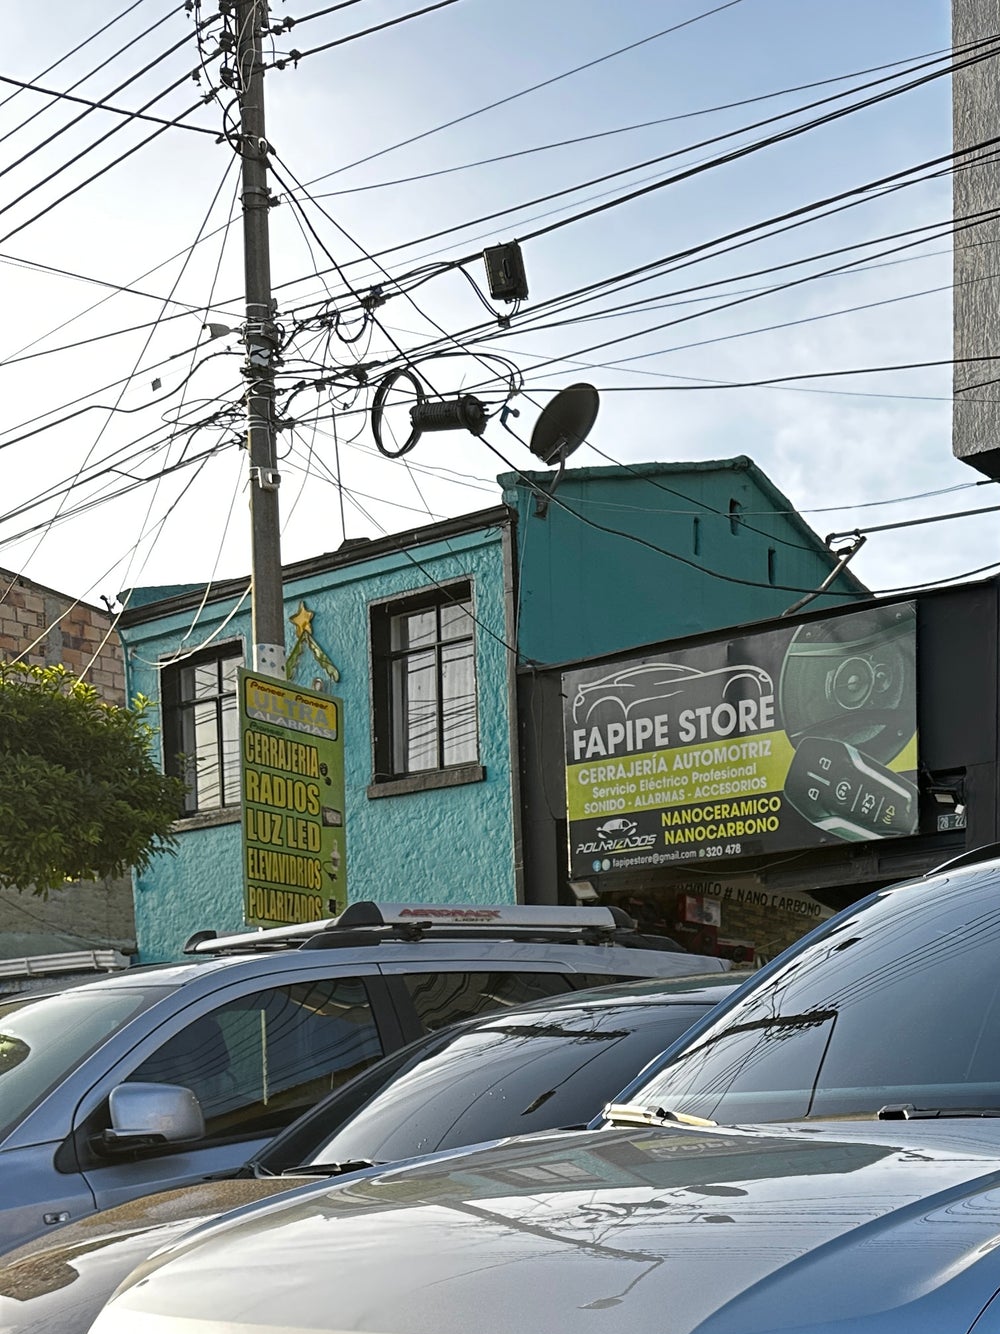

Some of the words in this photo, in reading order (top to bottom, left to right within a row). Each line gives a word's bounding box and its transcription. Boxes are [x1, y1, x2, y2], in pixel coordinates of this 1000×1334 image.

[254, 690, 329, 725] ULTRA
[294, 694, 329, 710] Pioneer
[253, 711, 331, 738] ALARMAS
[573, 714, 669, 761] FAPIPE
[679, 695, 775, 743] STORE
[244, 728, 320, 779] CERRAJERIA
[578, 752, 668, 785] CERRAJERÍA
[672, 739, 772, 771] AUTOMOTRIZ
[245, 768, 321, 817] RADIOS
[584, 799, 626, 815] SONIDO
[634, 789, 685, 807] ALARMAS
[694, 776, 767, 798] ACCESORIOS
[592, 781, 637, 798] Servicio
[640, 775, 688, 792] Eléctrico
[692, 763, 757, 784] Profesional
[661, 796, 782, 827] NANOCERAMICO
[246, 807, 284, 846] LUZ
[286, 815, 322, 853] LED
[575, 834, 658, 855] POLARIZADOS
[664, 816, 780, 846] NANOCARBONO
[612, 849, 697, 868] fapipestore@gmail.com
[705, 845, 723, 858] 320
[725, 843, 742, 855] 478
[246, 846, 323, 891] ELEVAVIDRIOS
[247, 884, 323, 924] POLARIZADOS
[737, 888, 768, 906] NANO
